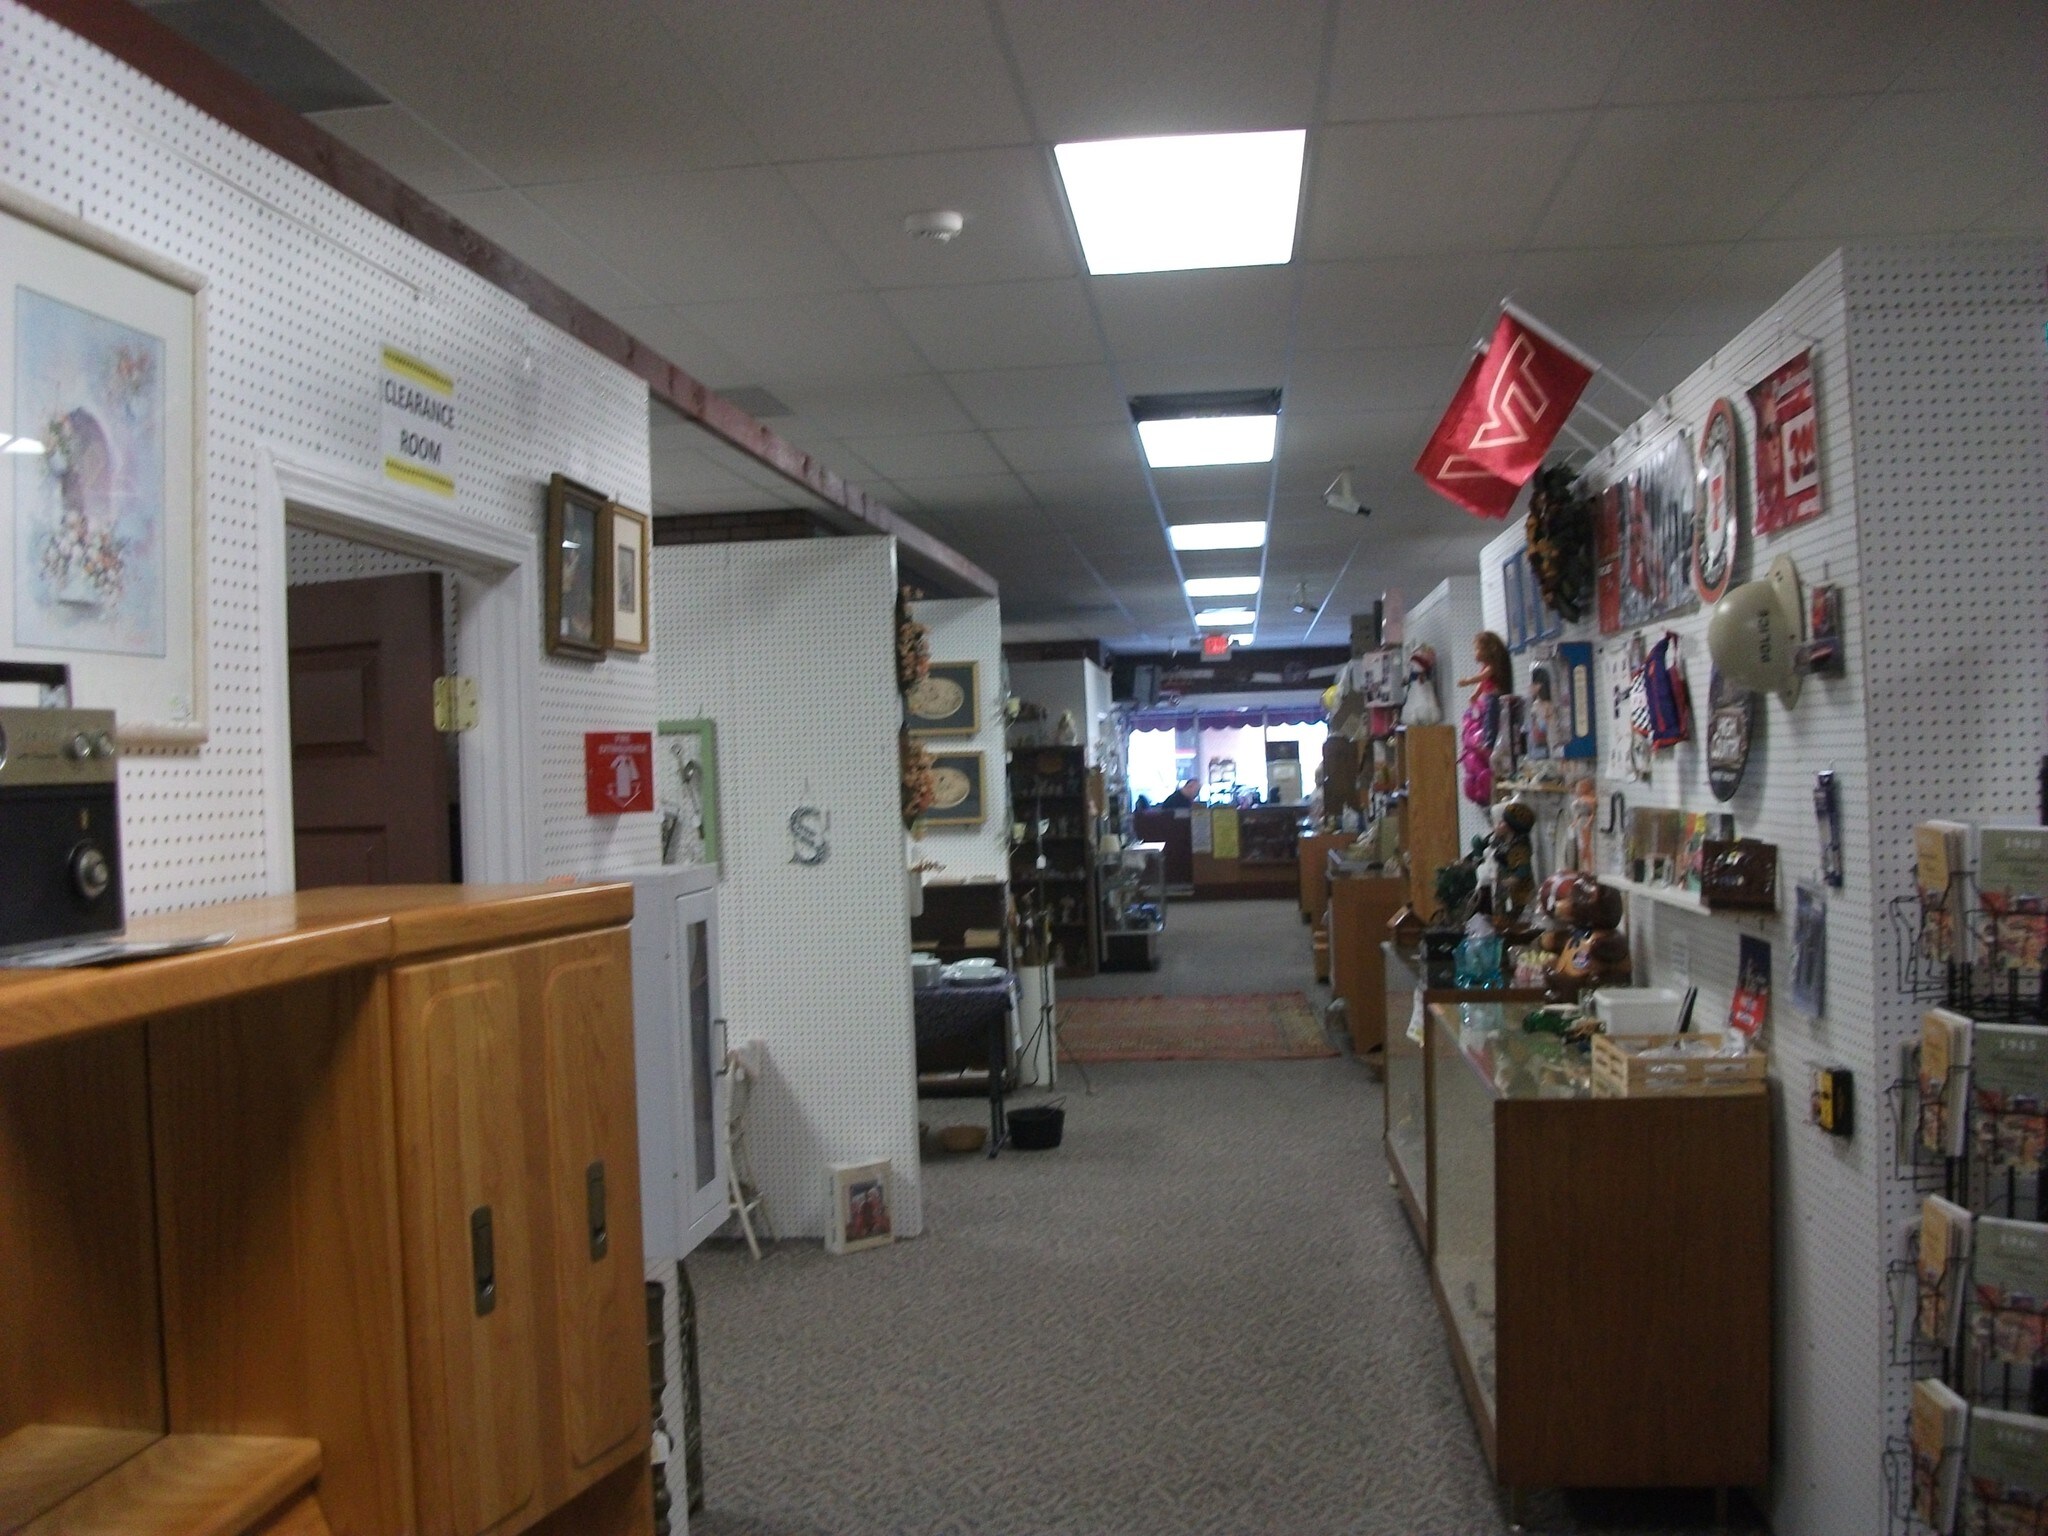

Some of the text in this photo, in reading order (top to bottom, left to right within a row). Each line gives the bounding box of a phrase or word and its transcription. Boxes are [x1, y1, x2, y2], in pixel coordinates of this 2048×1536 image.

[384, 378, 455, 430] CLEARANCE
[400, 428, 442, 464] ROOM
[1757, 608, 1772, 664] POLICE
